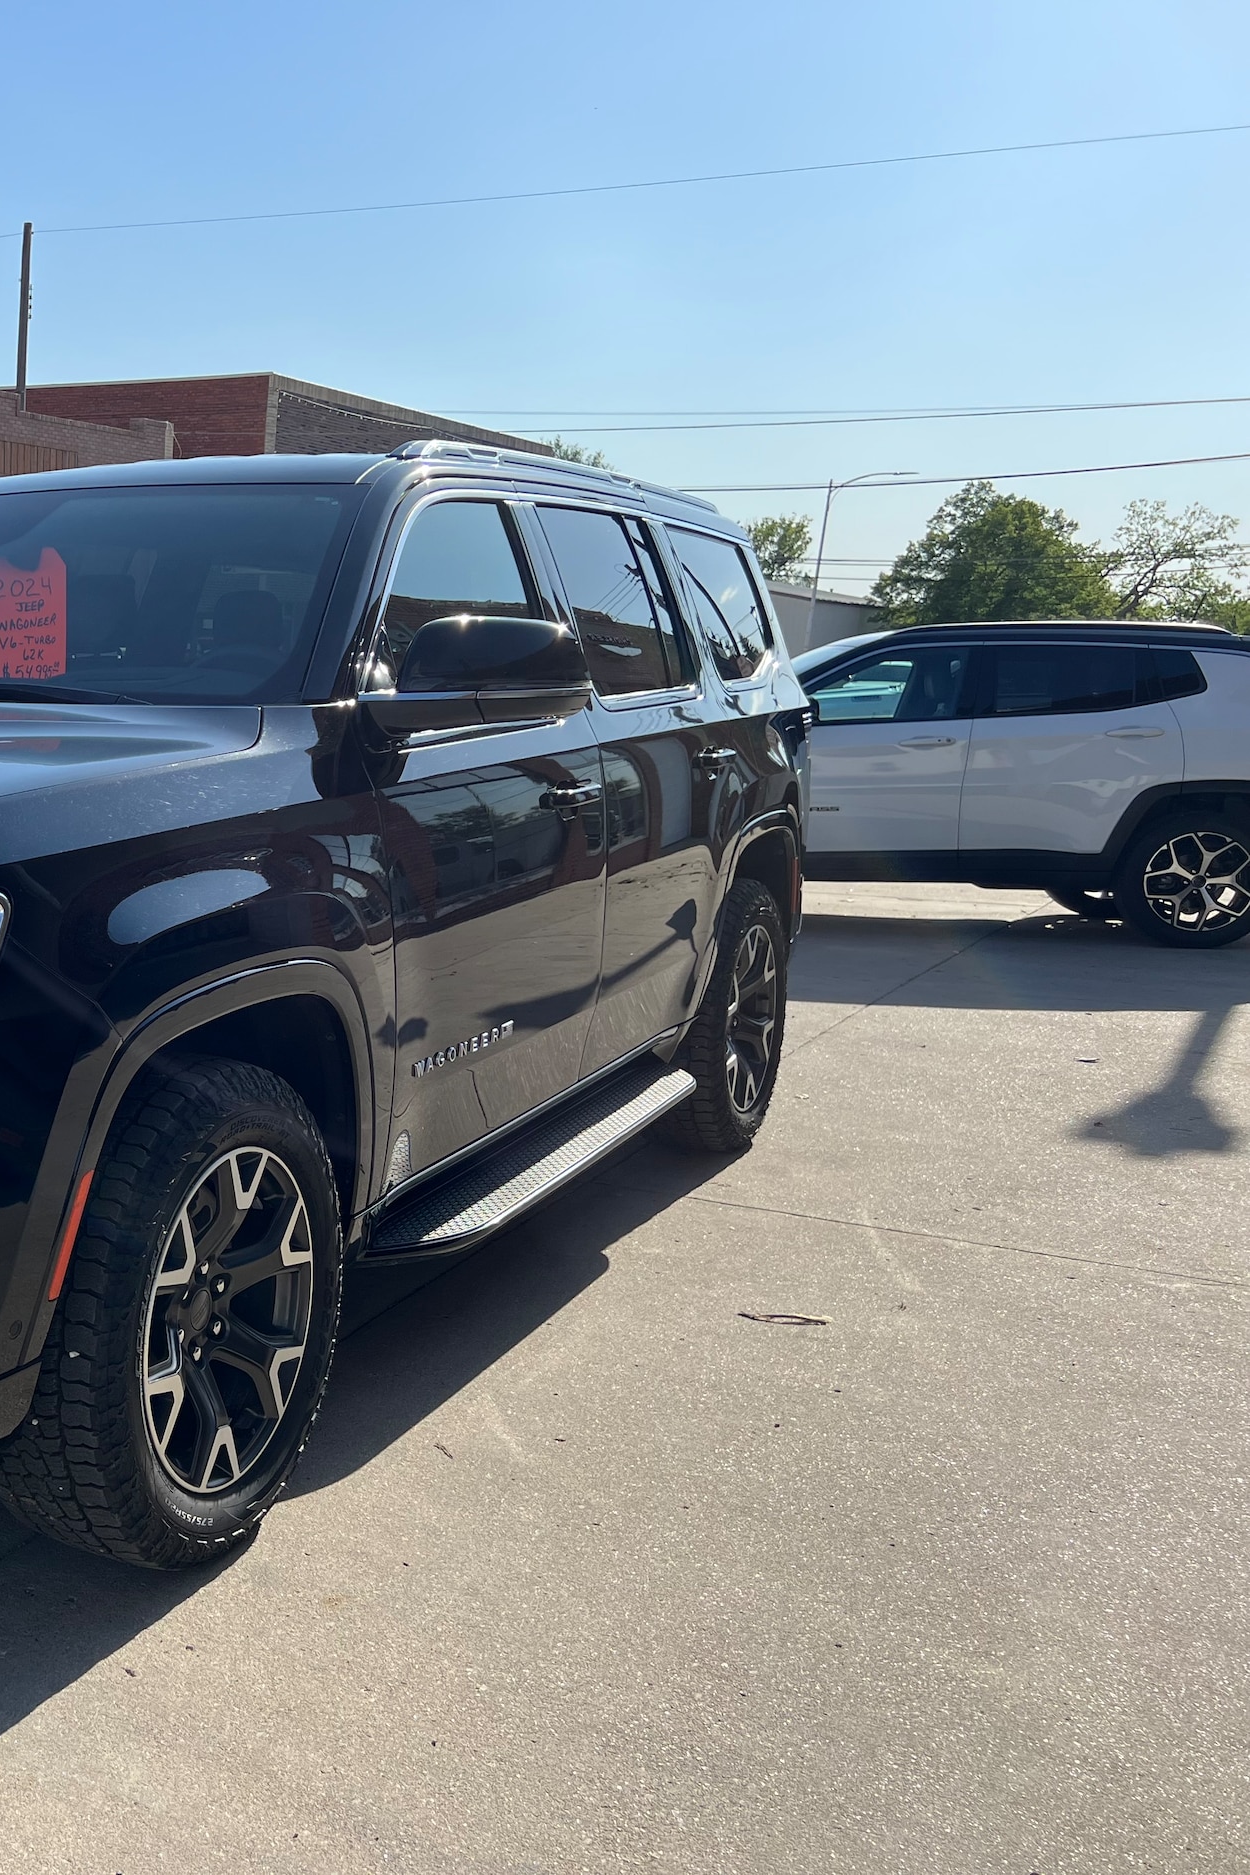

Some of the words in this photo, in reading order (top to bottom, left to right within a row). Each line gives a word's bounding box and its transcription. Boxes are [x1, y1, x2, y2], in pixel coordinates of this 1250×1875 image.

[15, 599, 45, 612] JEEP
[23, 649, 44, 660] 62K
[411, 1027, 501, 1078] WAGONEER
